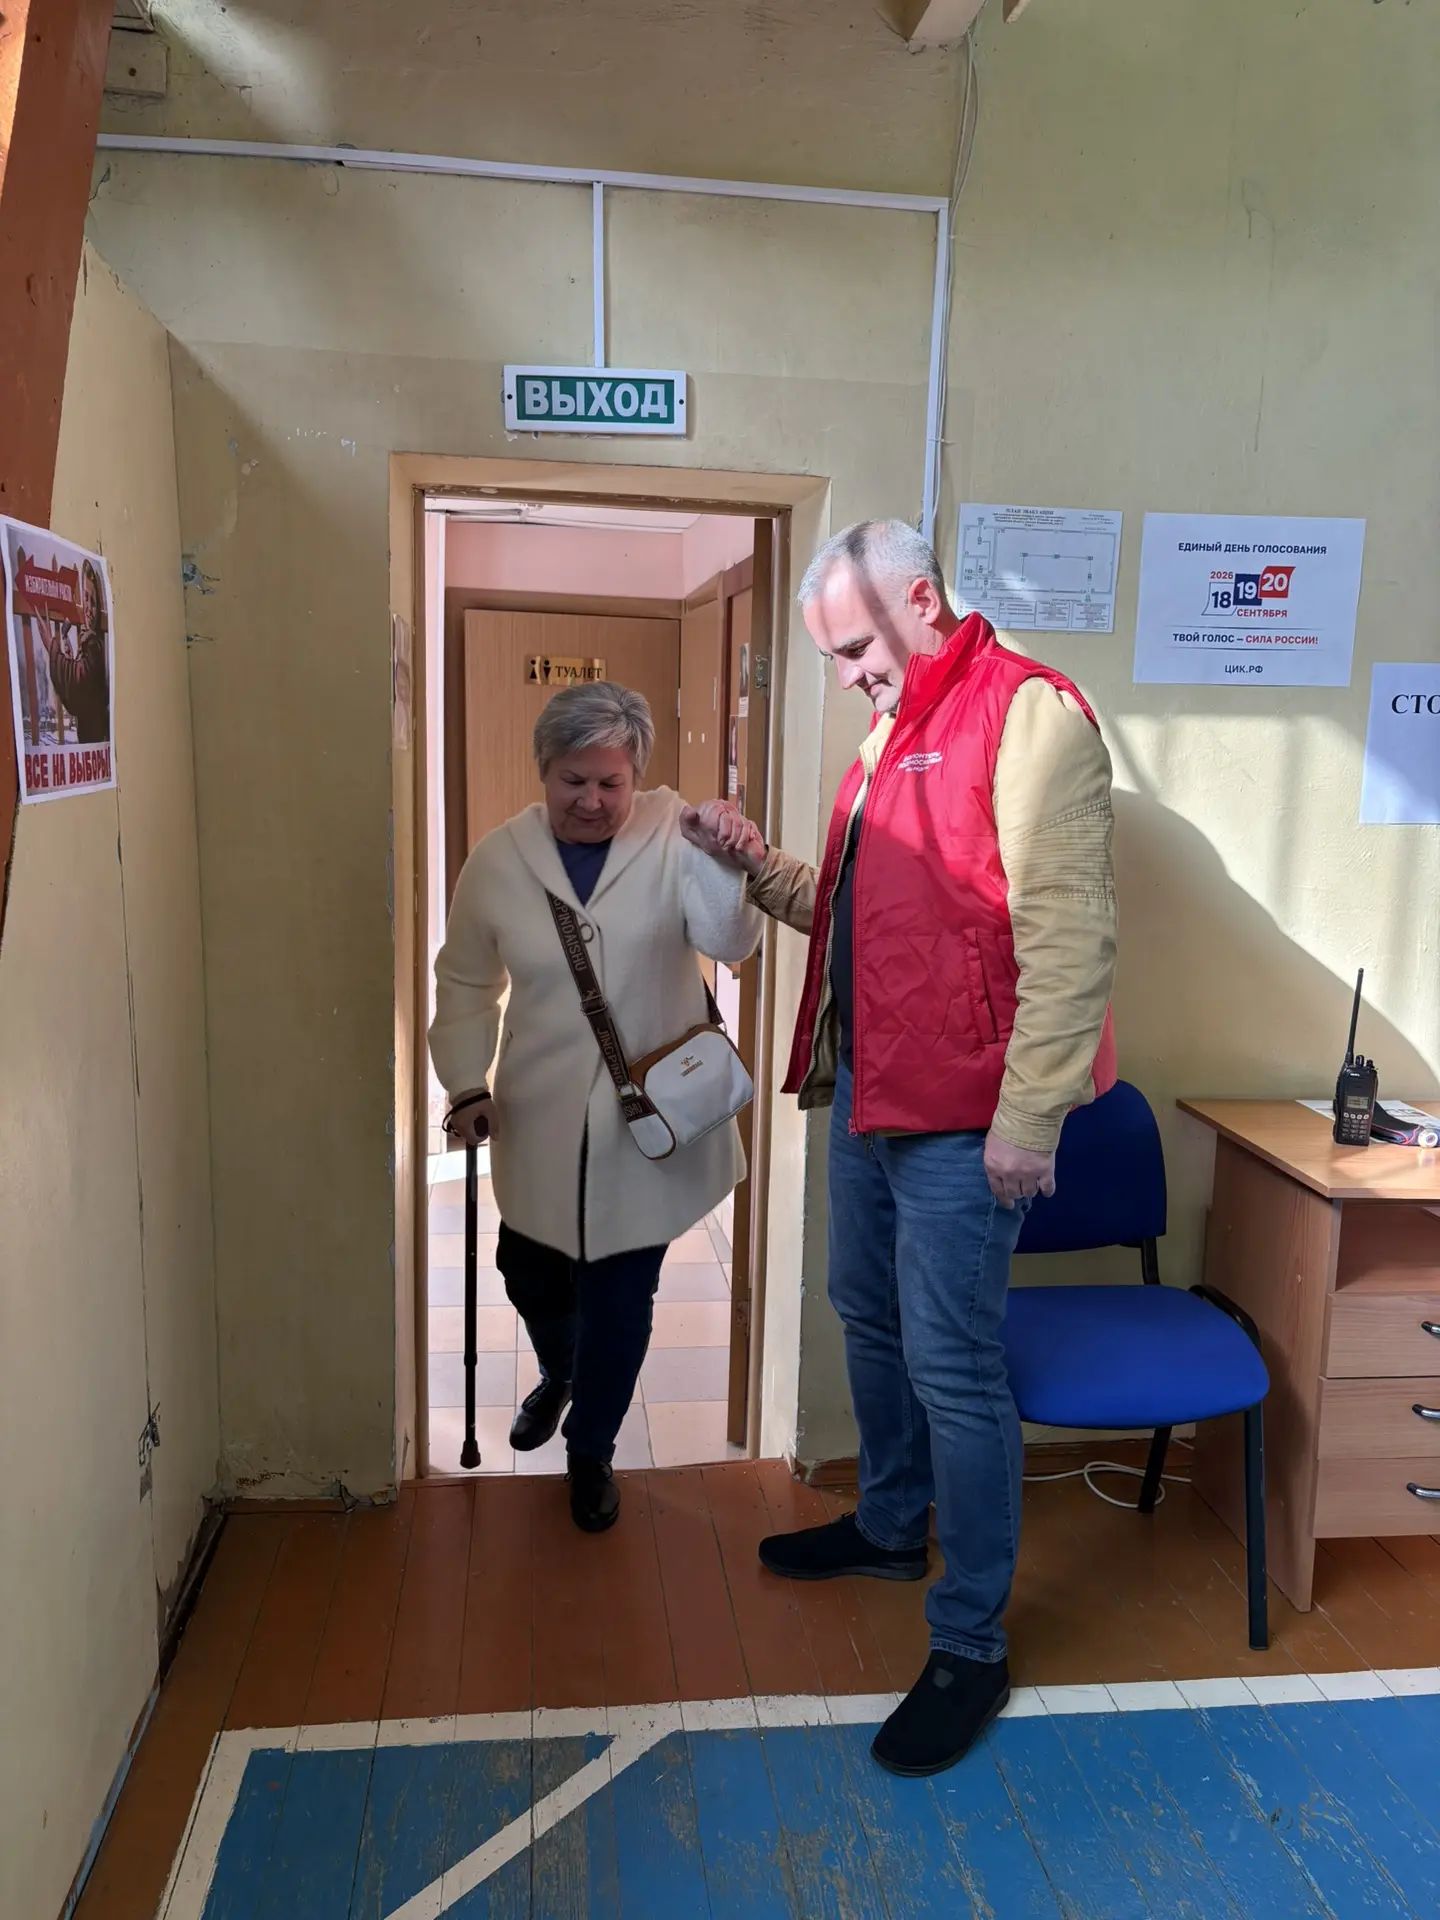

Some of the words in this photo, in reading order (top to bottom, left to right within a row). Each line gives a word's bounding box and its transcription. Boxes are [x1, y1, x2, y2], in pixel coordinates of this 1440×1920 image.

[523, 380, 668, 419] ВЫХОД
[1178, 541, 1222, 552] ЕДИНЫЙ
[1224, 543, 1251, 554] ДЕНЬ
[1252, 544, 1327, 555] ГОЛОСОВАНИЯ
[1209, 571, 1234, 580] 2026
[1211, 591, 1232, 609] 18
[1236, 581, 1258, 600] 19
[1261, 572, 1288, 592] 20
[1236, 608, 1288, 618] СЕНТЯБРЯ
[1172, 631, 1200, 642] ТВОЙ
[1201, 633, 1235, 643] ГОЛОС
[1245, 635, 1273, 644] СИЛА
[1274, 635, 1319, 645] РОССИИ!
[555, 665, 602, 679] ТУАЛЕТ
[1224, 665, 1264, 675] ЦИК.РФ
[1391, 694, 1440, 715] СТО
[24, 753, 49, 789] ВСЕ
[52, 753, 67, 787] НА
[69, 746, 112, 785] ВЫБОРЫ!
[551, 896, 588, 972] GPINDAISHU
